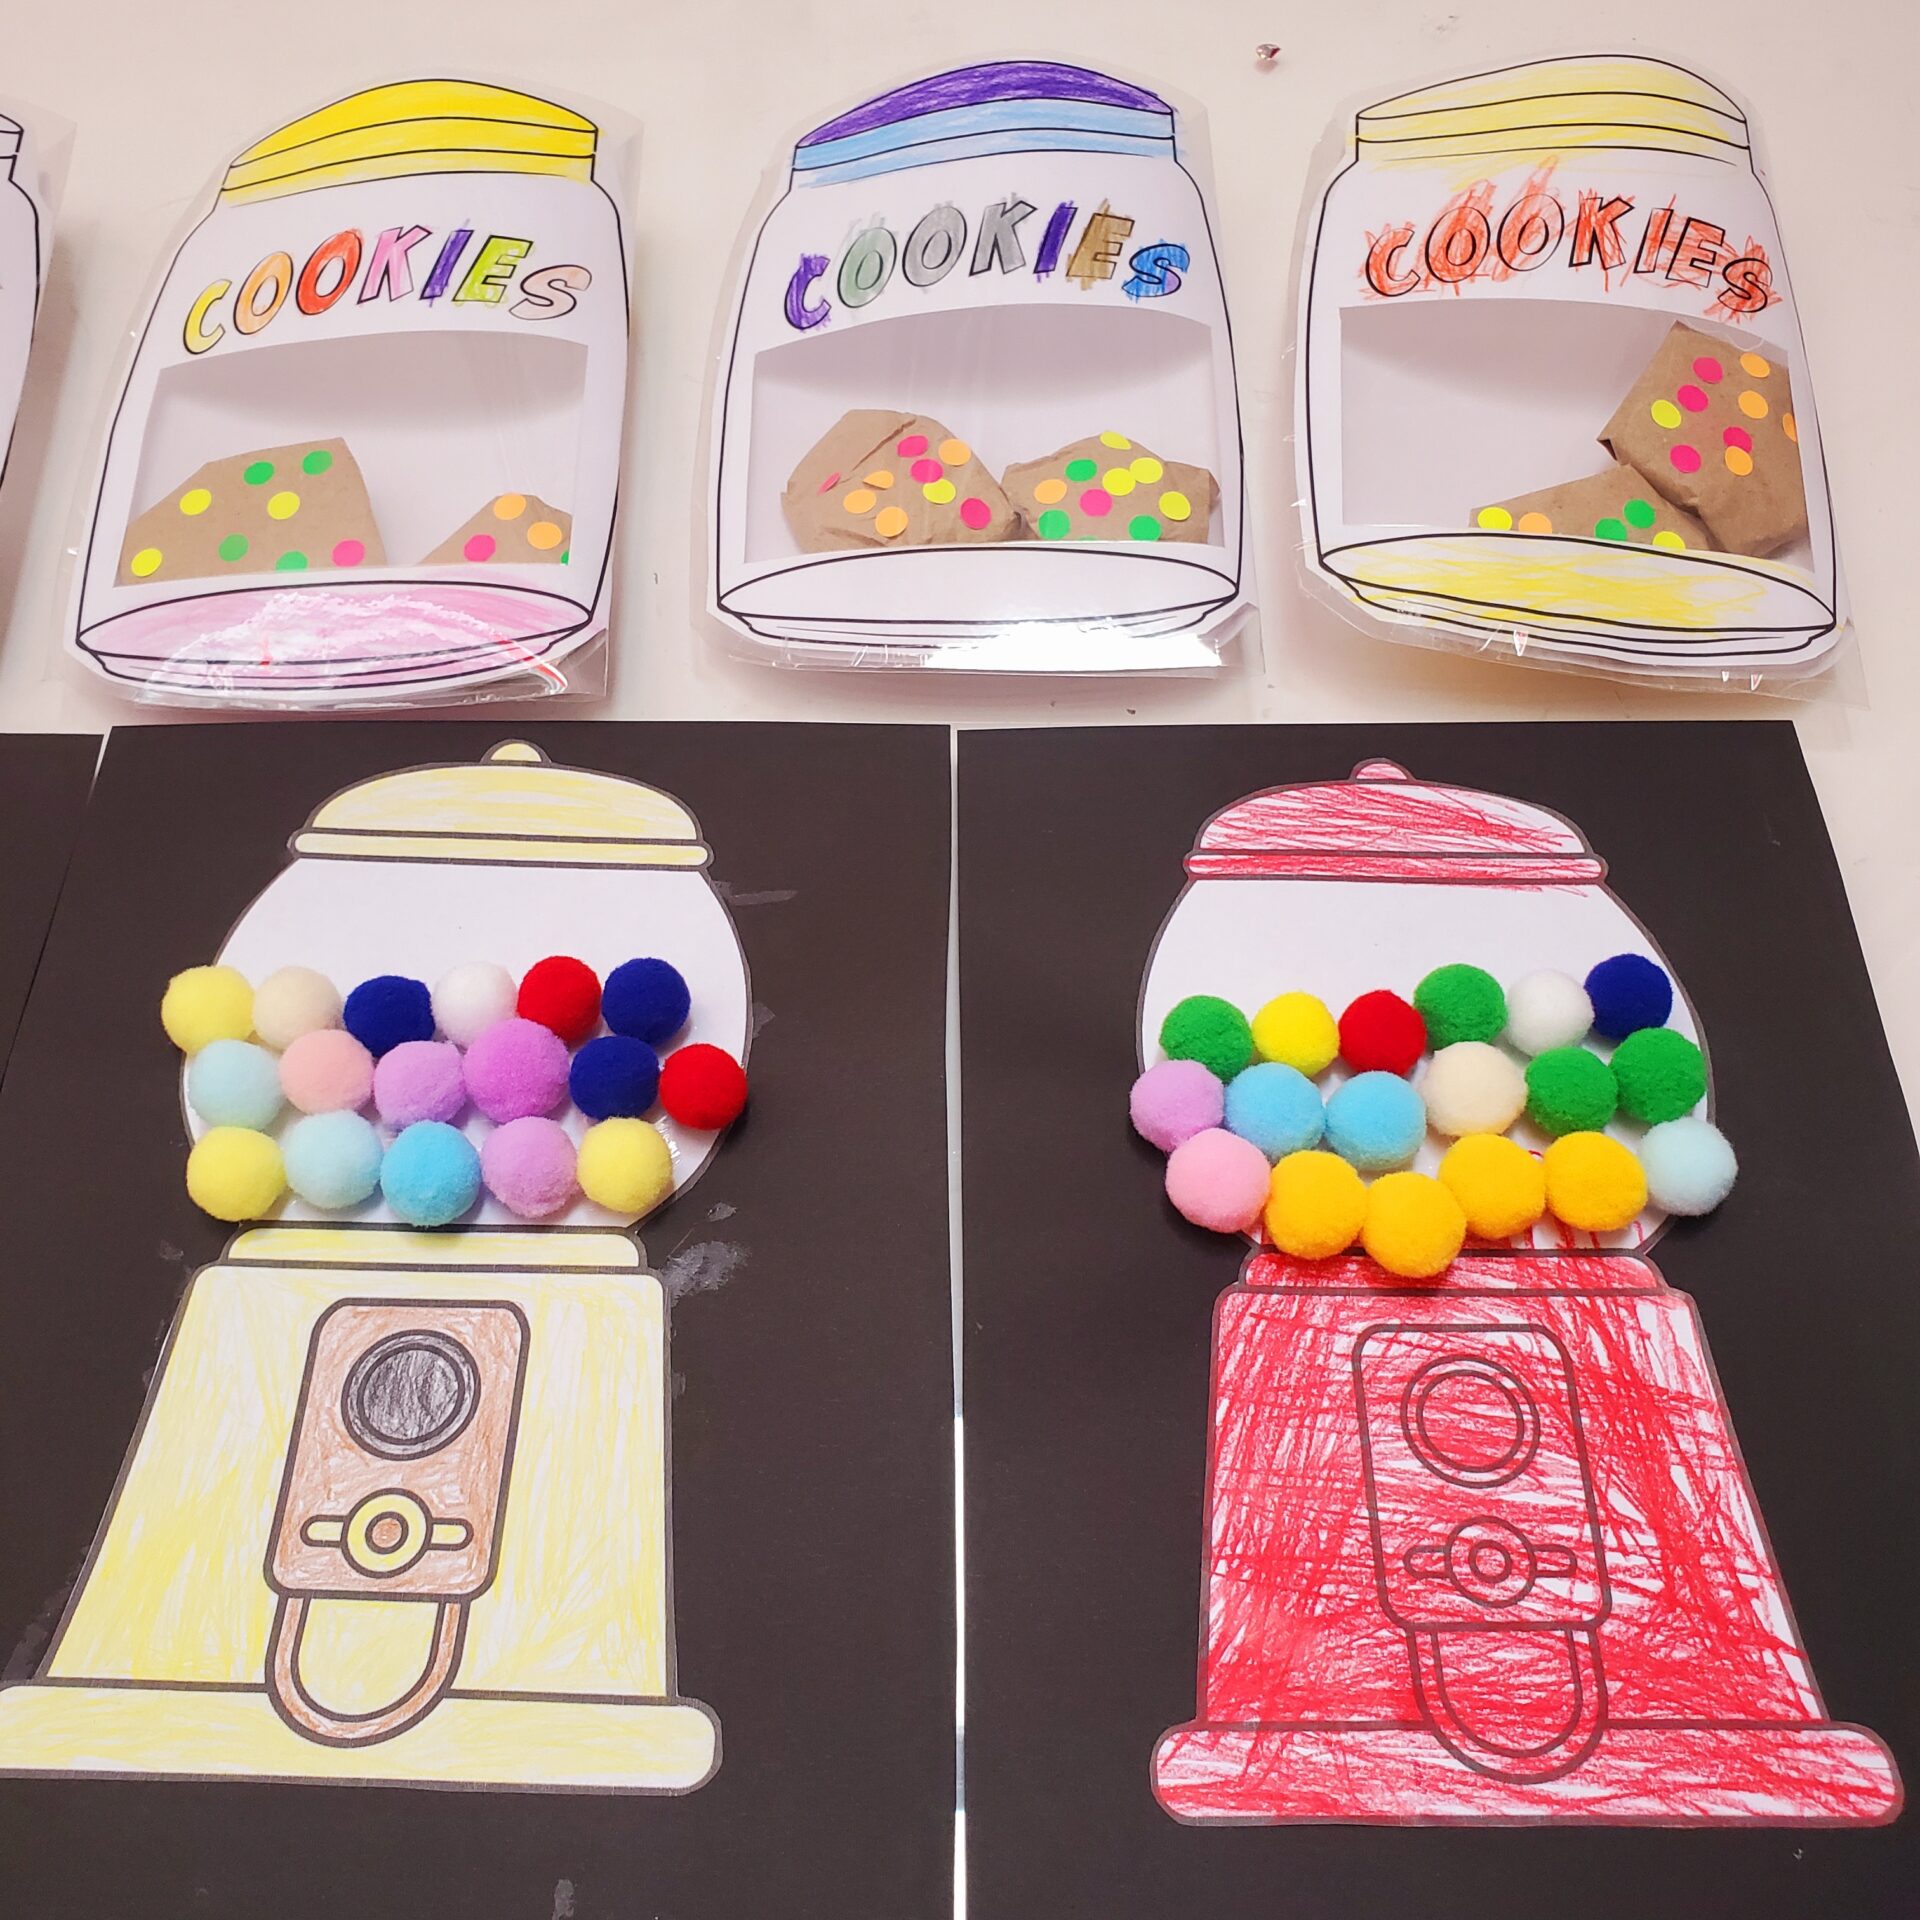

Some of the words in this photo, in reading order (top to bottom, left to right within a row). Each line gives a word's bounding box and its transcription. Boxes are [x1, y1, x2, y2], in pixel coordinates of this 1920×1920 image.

[183, 226, 593, 355] COOKIES
[784, 199, 1190, 331] COOKIES
[1365, 194, 1774, 313] COOKIES
